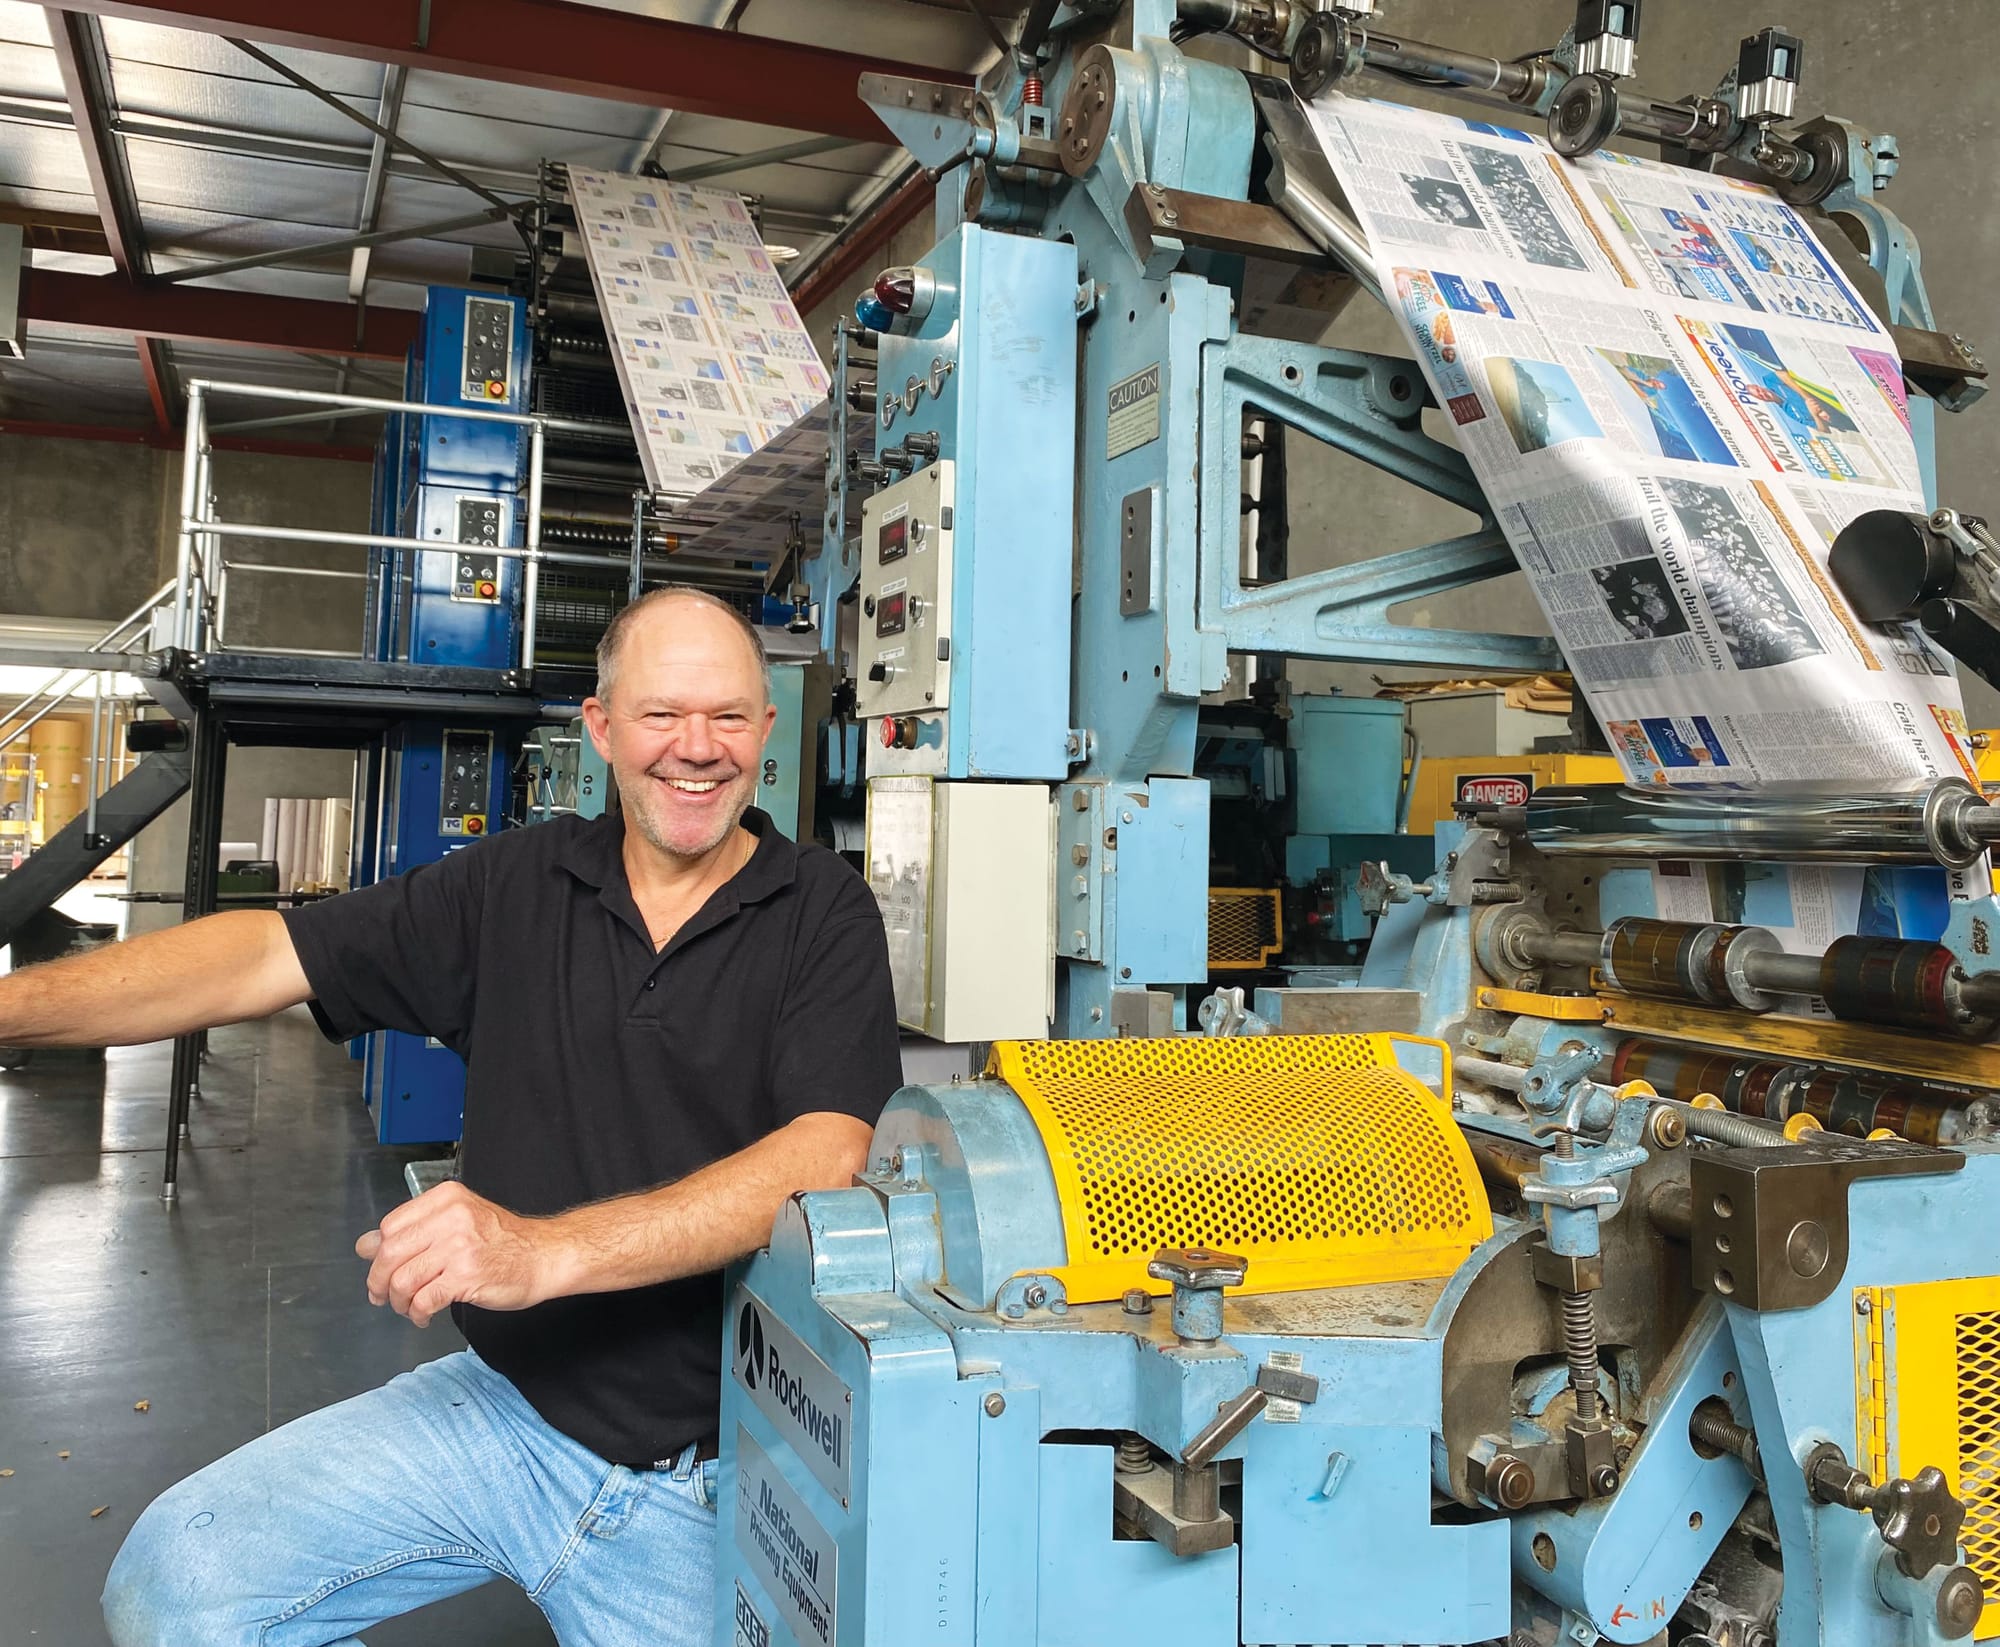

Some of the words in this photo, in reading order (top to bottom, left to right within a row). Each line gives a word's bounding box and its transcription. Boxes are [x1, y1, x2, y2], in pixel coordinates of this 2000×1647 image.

[1440, 139, 1460, 159] Hail
[1453, 160, 1466, 175] the
[1464, 177, 1487, 206] world
[1480, 206, 1516, 259] champions
[1630, 242, 1679, 297] Sport
[1110, 369, 1157, 411] CAUTION
[1643, 308, 1662, 334] Craig
[1660, 333, 1673, 350] has
[1669, 350, 1700, 391] returned
[1695, 391, 1706, 402] to
[1702, 401, 1724, 427] serve
[1720, 424, 1751, 469] Barmera
[1706, 338, 1759, 406] Pioneer
[1753, 407, 1804, 473] Murray
[1794, 435, 1826, 473] CRAIG'S
[1820, 437, 1852, 477] CALLING
[1637, 476, 1656, 505] Hail
[1650, 508, 1668, 534] the
[1660, 537, 1688, 585] world
[1680, 588, 1726, 672] champions
[1892, 702, 1912, 736] Craig
[1911, 738, 1930, 761] has
[1954, 748, 1972, 772] TODAY
[1465, 784, 1523, 802] DANGER
[769, 1343, 842, 1469] Rockwell
[760, 1479, 819, 1585] National
[749, 1518, 780, 1578] Printing
[782, 1555, 828, 1645] Equipment
[938, 1556, 949, 1628] D15746
